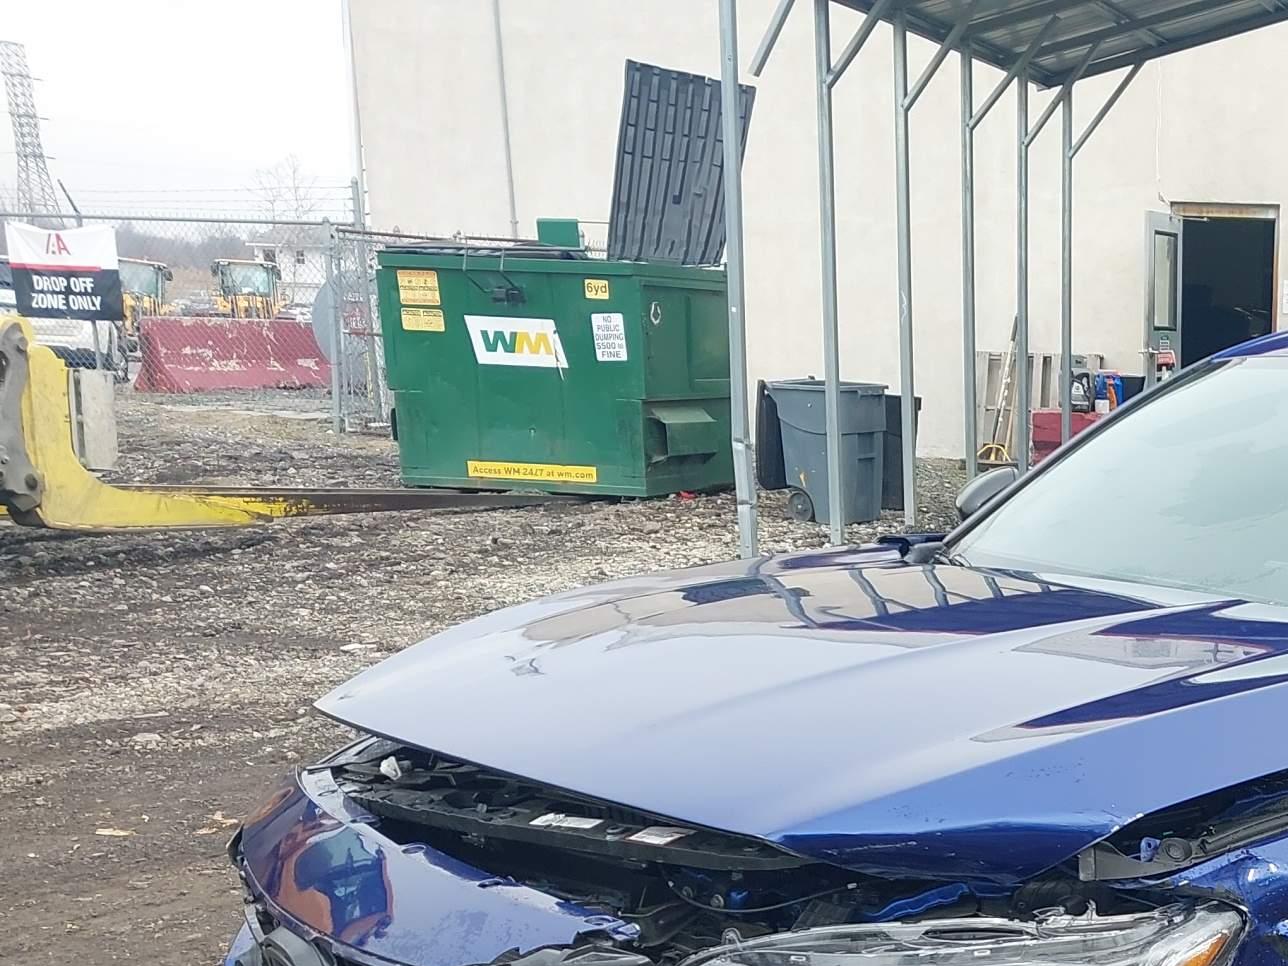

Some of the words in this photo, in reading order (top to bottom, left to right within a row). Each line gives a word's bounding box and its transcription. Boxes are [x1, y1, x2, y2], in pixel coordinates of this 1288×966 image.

[32, 275, 67, 292] DROP
[69, 277, 94, 293] OFF
[586, 282, 608, 296] 6yd
[31, 293, 68, 309] ZONE
[69, 295, 102, 311] ONLY
[602, 315, 612, 323] NO
[596, 324, 620, 332] PUBLIC
[480, 329, 554, 356] WM
[595, 332, 624, 341] DUMPING
[601, 350, 622, 359] FINE
[472, 466, 502, 475] Access
[503, 467, 520, 476] WM
[521, 467, 544, 477] 24/7
[546, 470, 555, 478] at
[557, 471, 595, 480] wm.com
